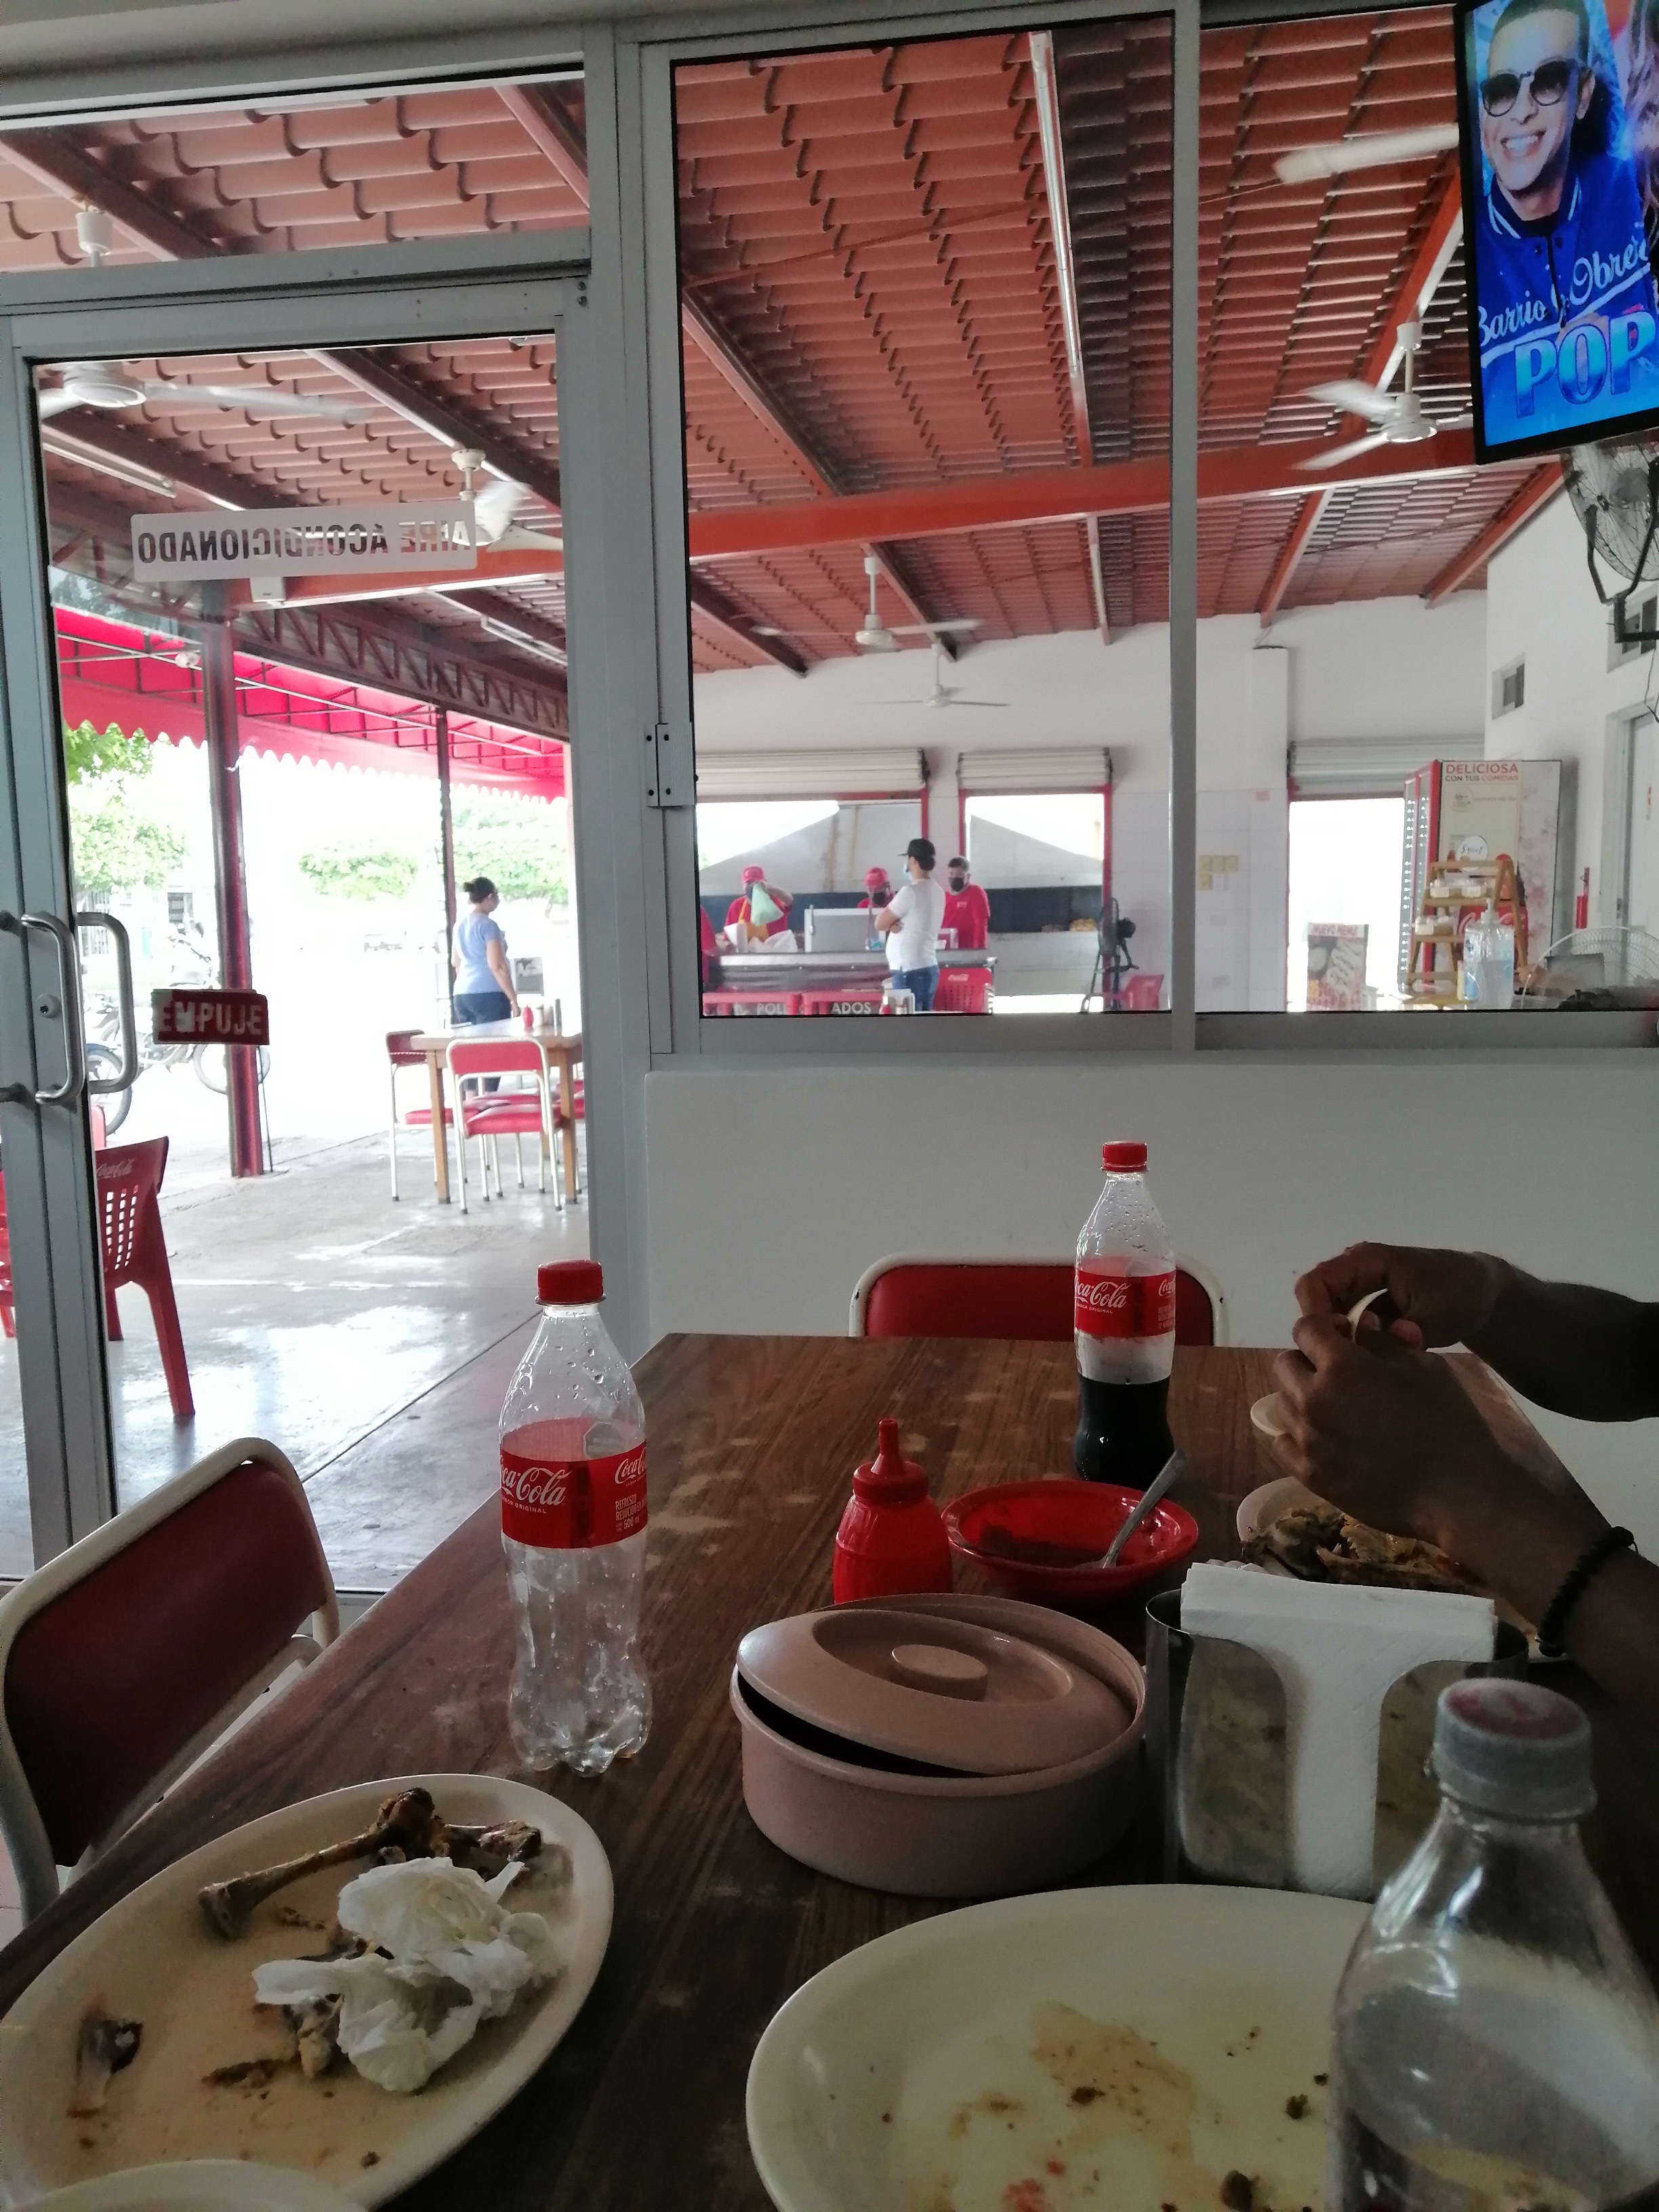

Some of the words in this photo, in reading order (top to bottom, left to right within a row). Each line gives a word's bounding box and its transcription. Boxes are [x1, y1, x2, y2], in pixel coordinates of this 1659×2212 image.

[1515, 311, 1656, 417] POP
[1446, 763, 1518, 774] DELICIOSA
[514, 1502, 547, 1514] ORIGINAL
